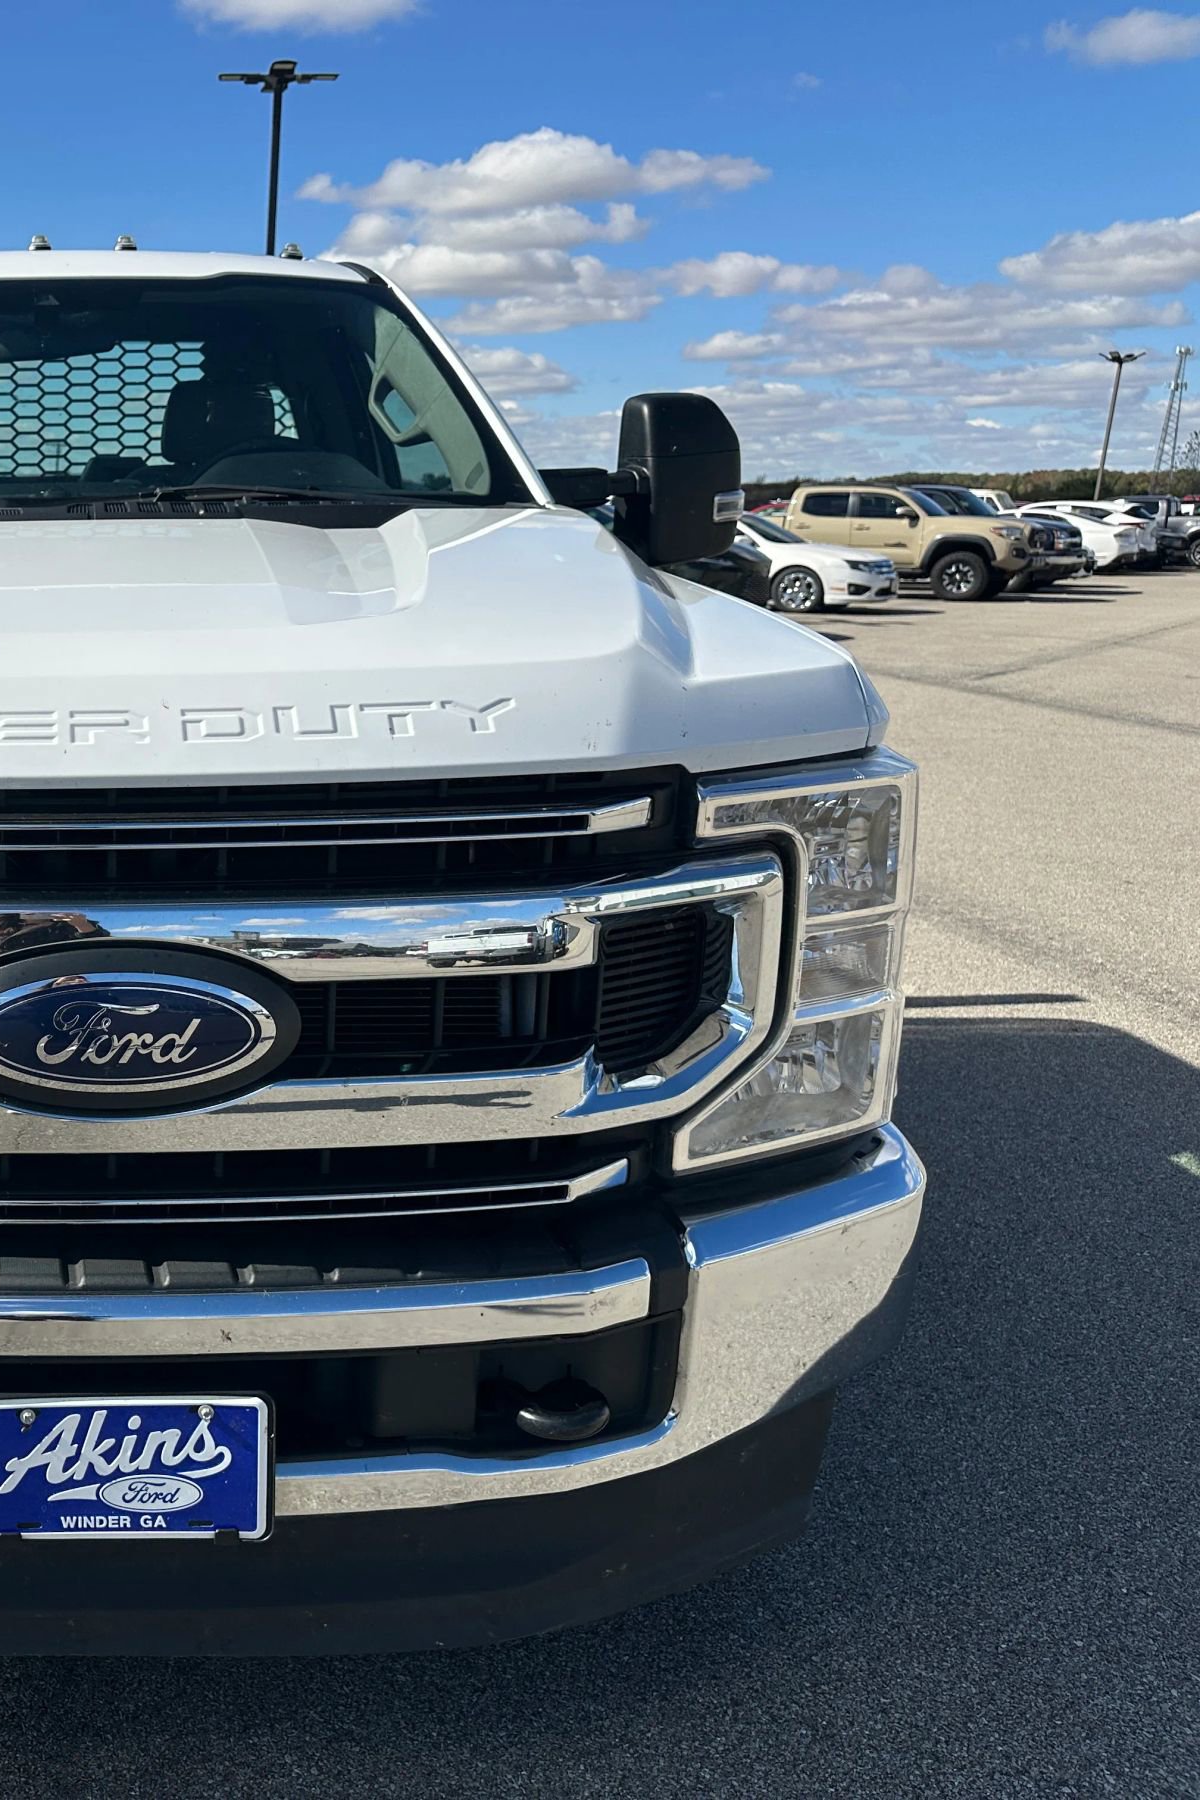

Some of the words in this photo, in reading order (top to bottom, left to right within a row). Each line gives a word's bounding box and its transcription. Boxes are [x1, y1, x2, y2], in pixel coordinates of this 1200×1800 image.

[180, 697, 517, 743] DUTY
[35, 1000, 202, 1065] Ford
[121, 1480, 180, 1505] Ford
[60, 1515, 132, 1529] WINDER
[139, 1514, 167, 1528] GA
